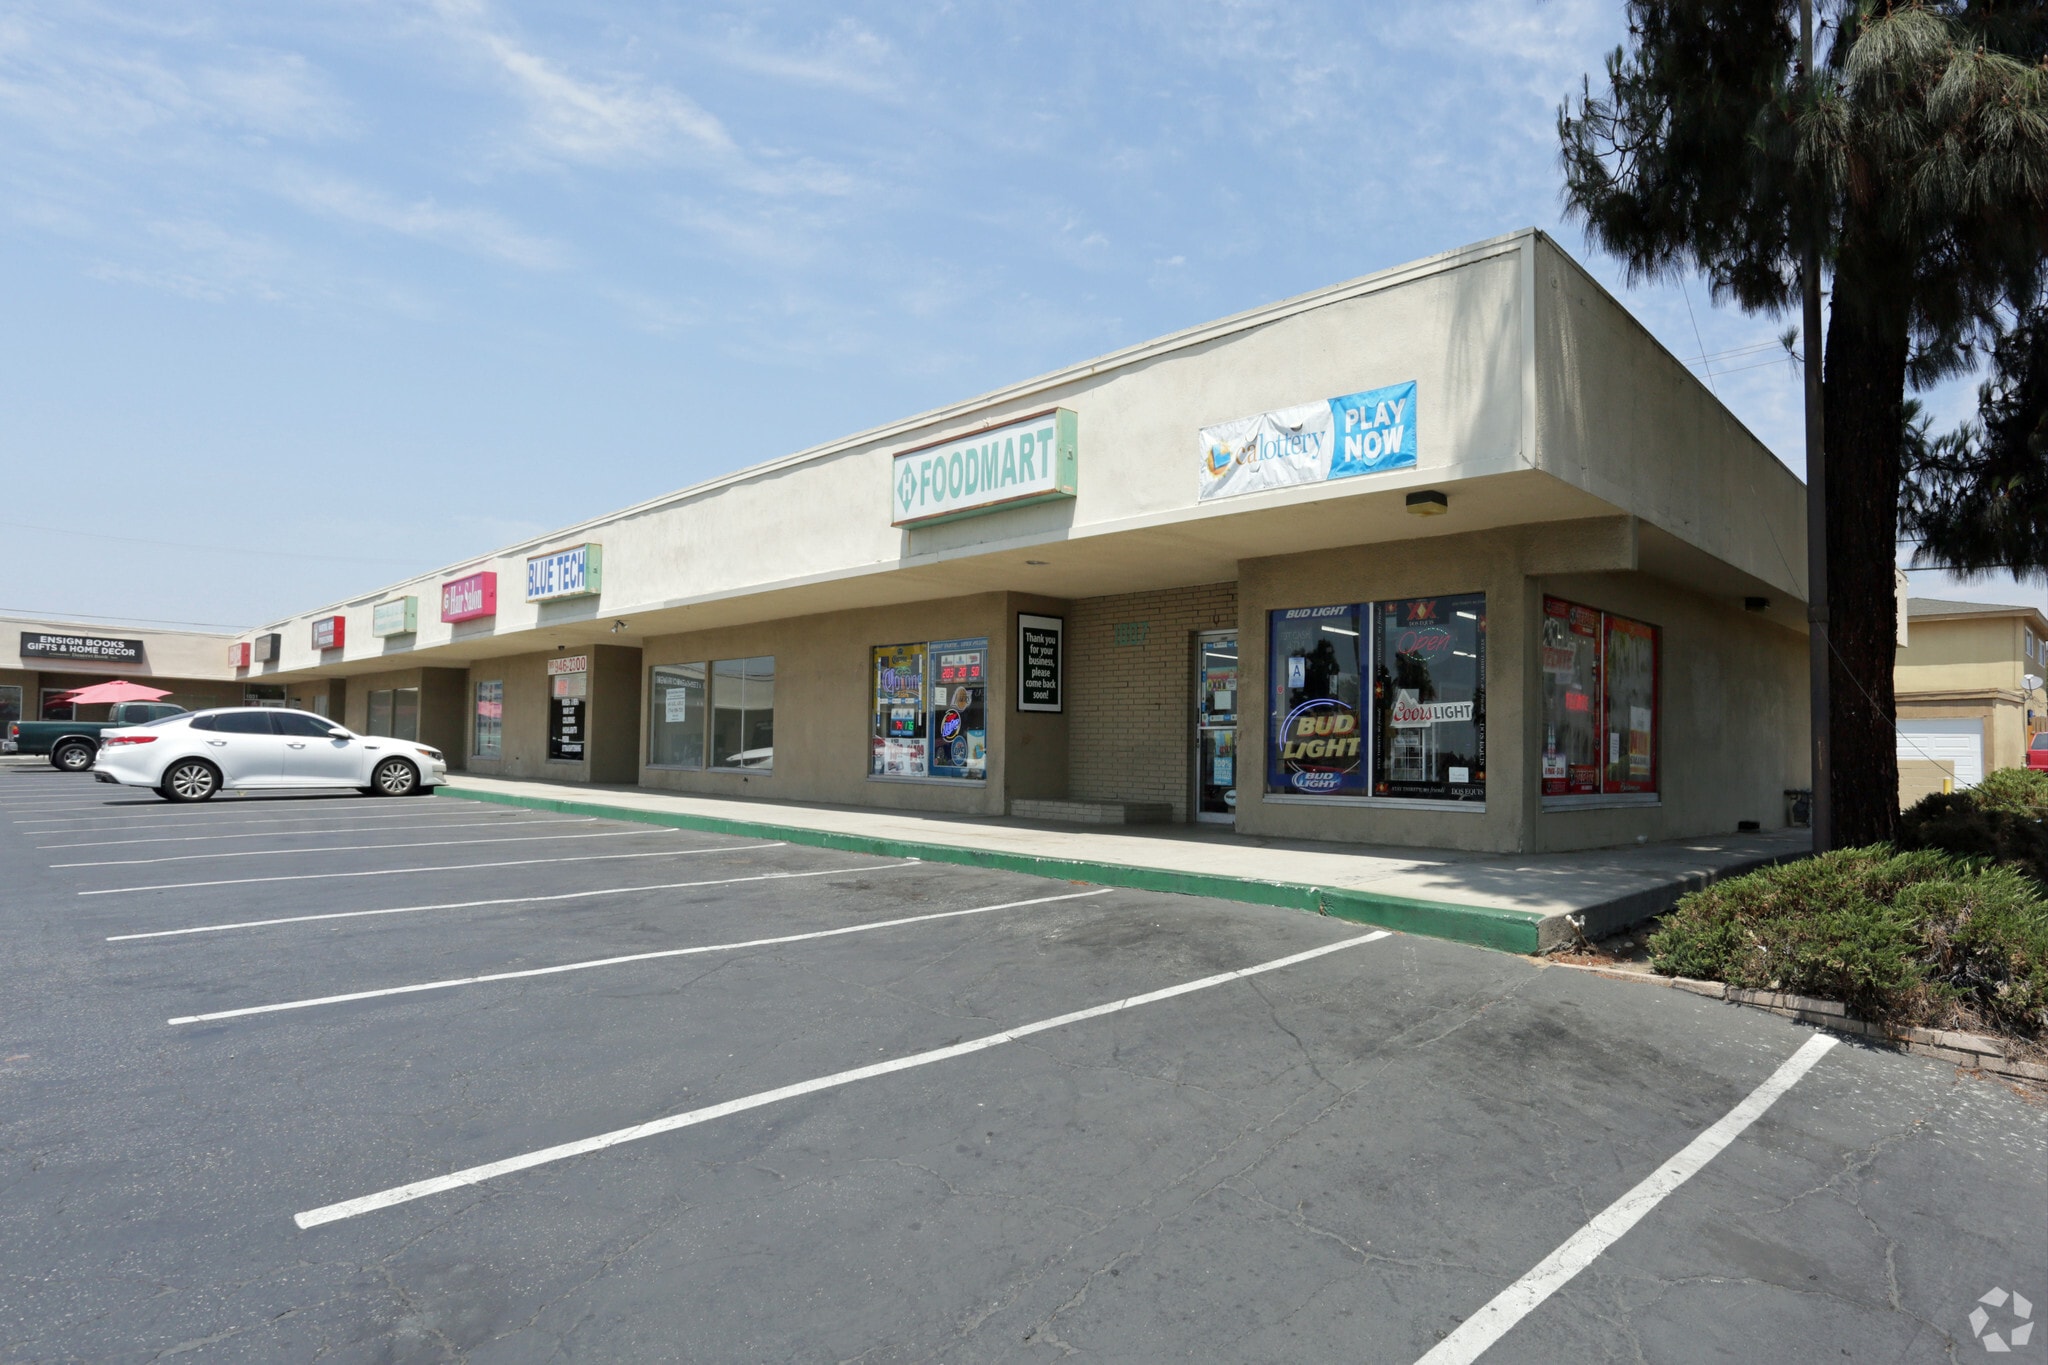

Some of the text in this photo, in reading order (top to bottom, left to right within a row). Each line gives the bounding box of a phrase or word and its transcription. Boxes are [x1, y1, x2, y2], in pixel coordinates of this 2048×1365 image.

[1345, 398, 1407, 433] PLAY
[1344, 425, 1405, 463] NOW
[920, 427, 1054, 506] FOODMART
[528, 551, 586, 597] BLUE TECH
[450, 583, 463, 615] Hair
[463, 580, 483, 613] Salon
[1285, 606, 1348, 619] BUD LIGHT
[1026, 632, 1056, 645] Thank you
[1114, 621, 1149, 647] 1007
[40, 635, 125, 648] ENSIGN BOOKS
[1398, 631, 1451, 655] Open
[27, 642, 57, 651] GIFTS
[69, 645, 99, 654] HOME
[101, 647, 136, 656] DECOR
[1030, 643, 1053, 657] for your
[1028, 655, 1055, 668] business,
[1031, 667, 1050, 678] please
[1293, 665, 1301, 677] A
[1025, 679, 1056, 689] come back
[1033, 690, 1049, 699] soon!
[1394, 701, 1471, 721] Coors LIGHT
[1296, 714, 1356, 737] BUD
[1283, 737, 1361, 760] LIGHT
[1305, 772, 1334, 780] BUD
[1299, 780, 1337, 788] LIGHT
[1451, 787, 1484, 798] DOS EQUIS
